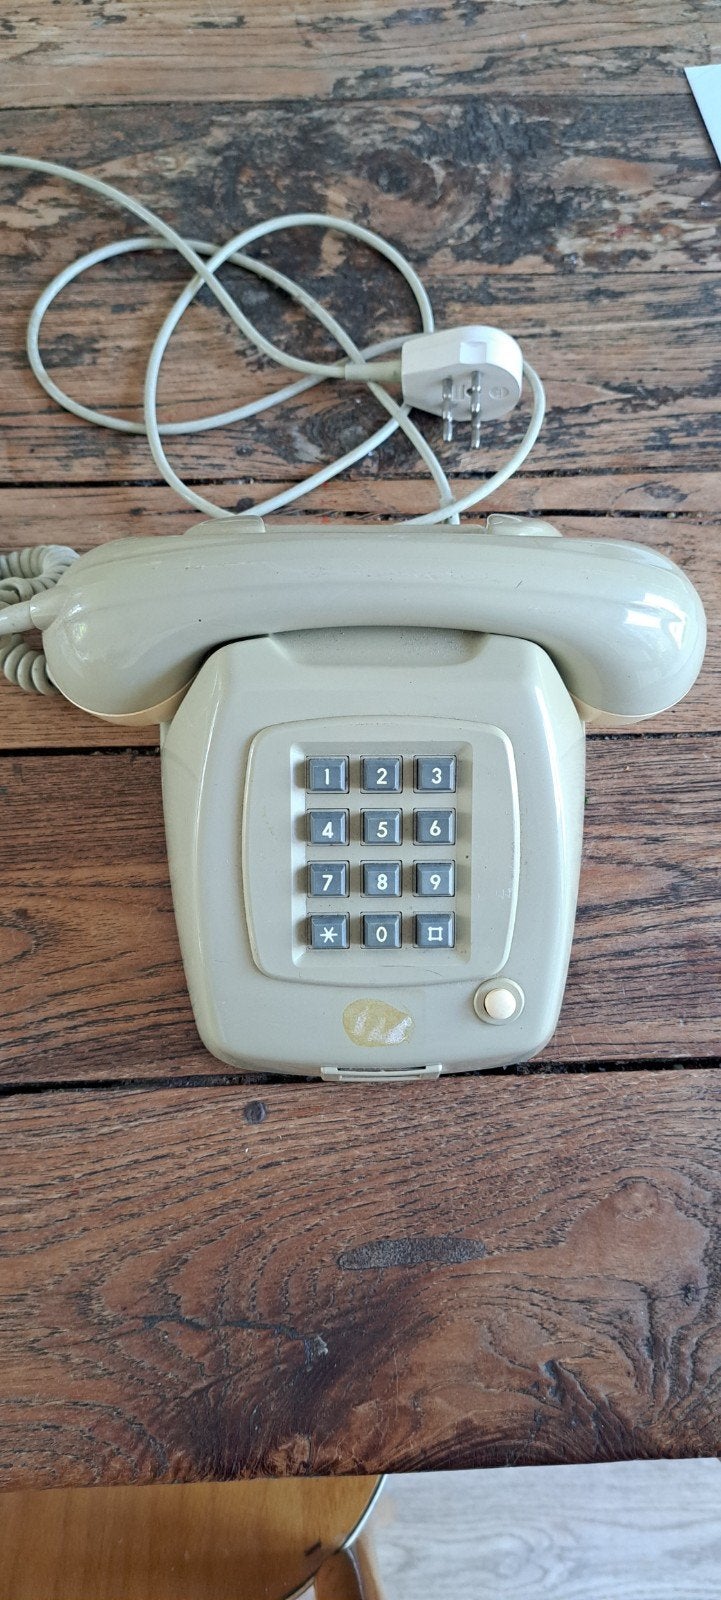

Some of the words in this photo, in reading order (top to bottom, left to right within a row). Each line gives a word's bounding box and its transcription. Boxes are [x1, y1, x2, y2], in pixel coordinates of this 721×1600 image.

[323, 768, 330, 786] 1
[376, 768, 388, 785] 2
[431, 768, 442, 785] 3
[321, 822, 334, 839] 4
[376, 821, 388, 838] 5
[429, 820, 442, 837] 6
[322, 874, 334, 892] 7
[376, 874, 388, 891] 8
[429, 874, 442, 890] 9
[375, 926, 388, 943] 0
